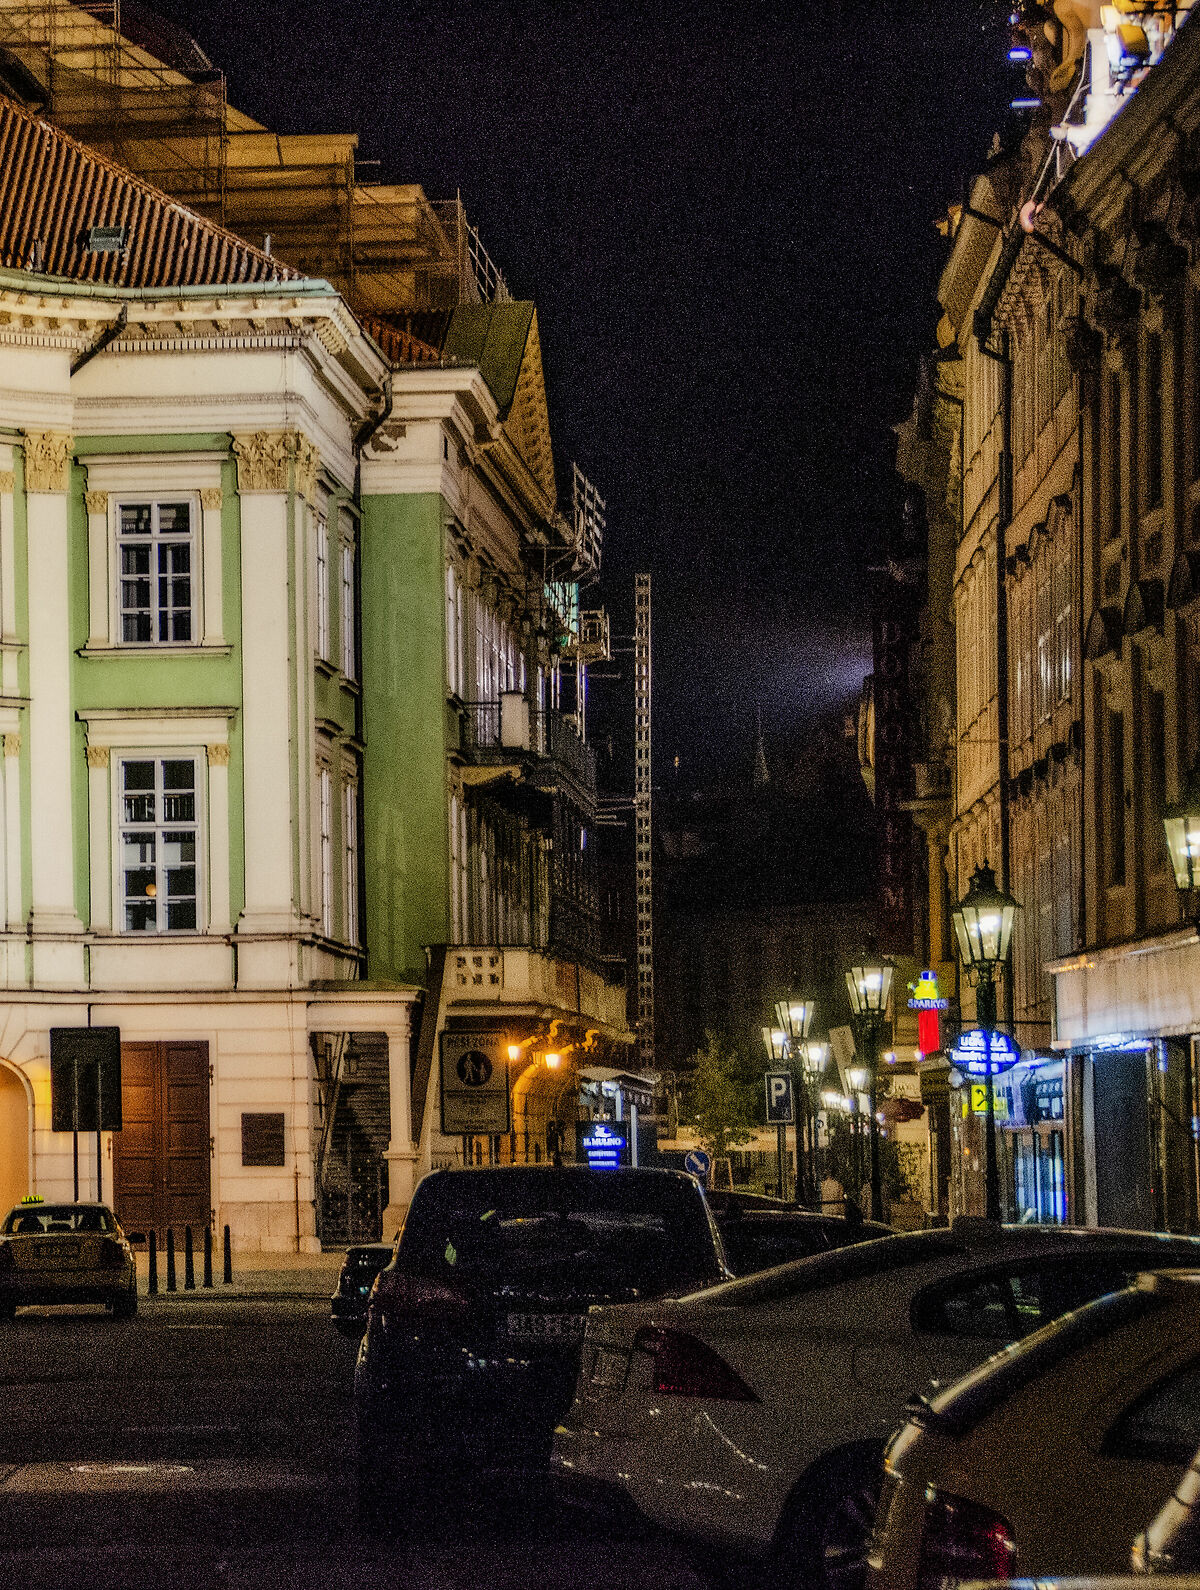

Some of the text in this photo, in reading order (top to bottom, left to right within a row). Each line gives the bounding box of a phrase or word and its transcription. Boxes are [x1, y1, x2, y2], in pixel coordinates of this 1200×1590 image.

[770, 1077, 787, 1108] P
[583, 1137, 621, 1146] IL MULINO
